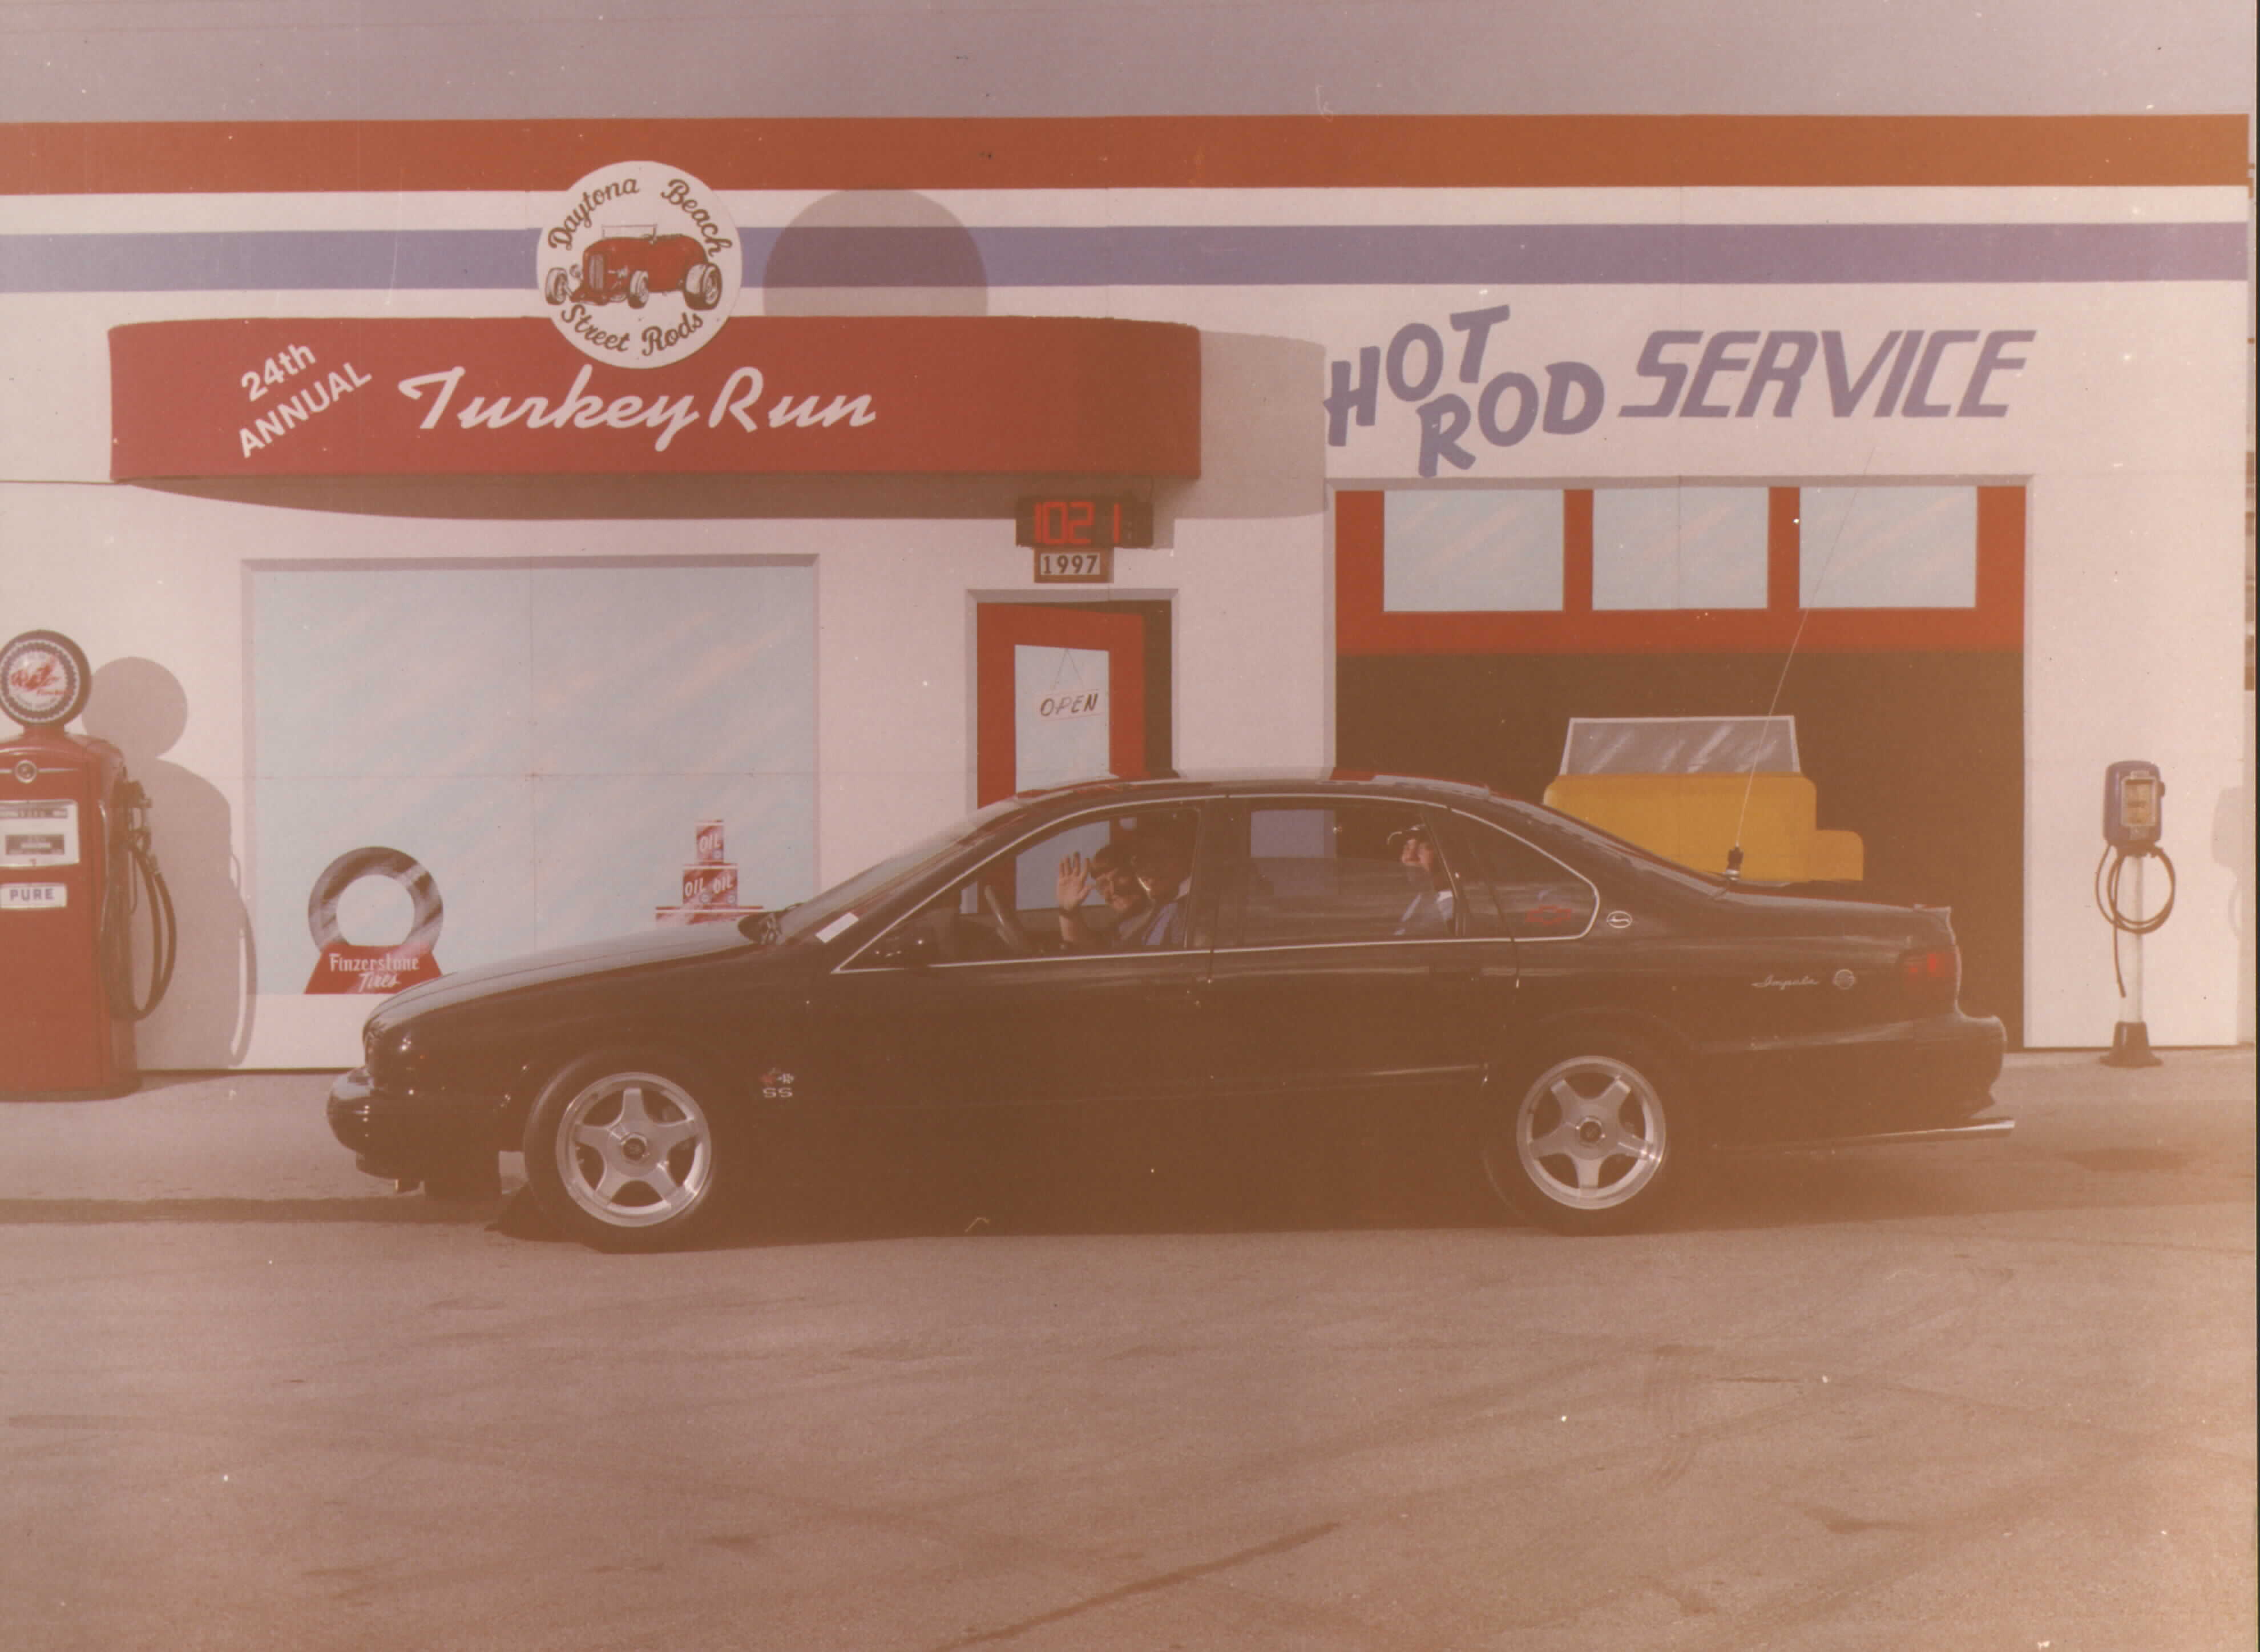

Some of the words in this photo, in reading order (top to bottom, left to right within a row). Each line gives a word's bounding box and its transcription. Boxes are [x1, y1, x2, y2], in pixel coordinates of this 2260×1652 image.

[548, 179, 639, 251] Daytona
[660, 179, 733, 257] Beach
[561, 304, 631, 352] Street
[641, 312, 704, 356] Rods
[241, 344, 316, 402] 24th
[1323, 304, 1510, 447] HOT
[1617, 330, 2036, 418] SERVICE
[239, 362, 372, 458] ANNUAL
[398, 364, 700, 453] Turkey
[708, 366, 876, 433] Run
[1415, 361, 1605, 478] ROD
[1043, 554, 1099, 575] 1997
[1040, 693, 1099, 717] OPEN
[699, 834, 720, 854] OIL
[9, 888, 55, 901] PURE
[685, 878, 707, 898] OIL
[713, 873, 733, 895] OIL
[762, 1086, 794, 1098] SS
